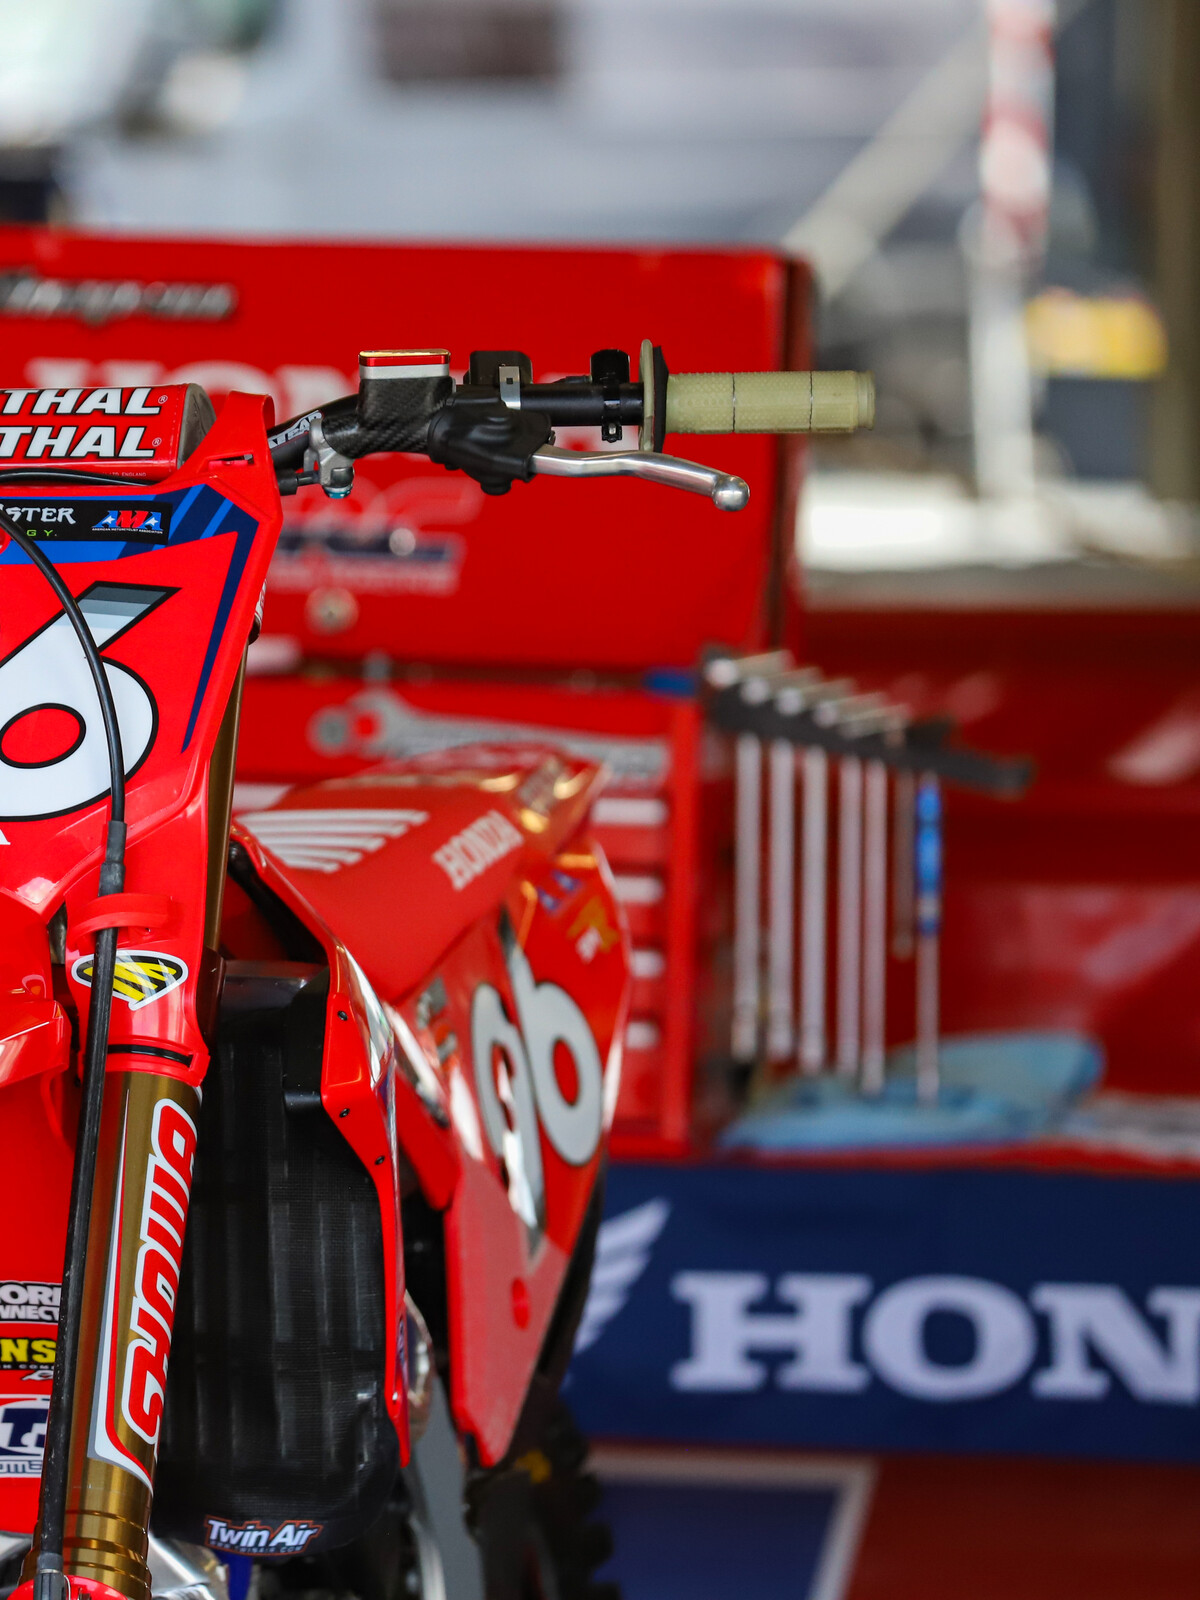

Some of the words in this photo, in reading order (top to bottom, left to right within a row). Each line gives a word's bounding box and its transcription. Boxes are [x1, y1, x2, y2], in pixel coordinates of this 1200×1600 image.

[91, 510, 164, 531] AMA
[471, 905, 604, 1258] 96
[19, 1363, 54, 1371] COM
[208, 1519, 271, 1547] Twin
[269, 1524, 319, 1547] Air
